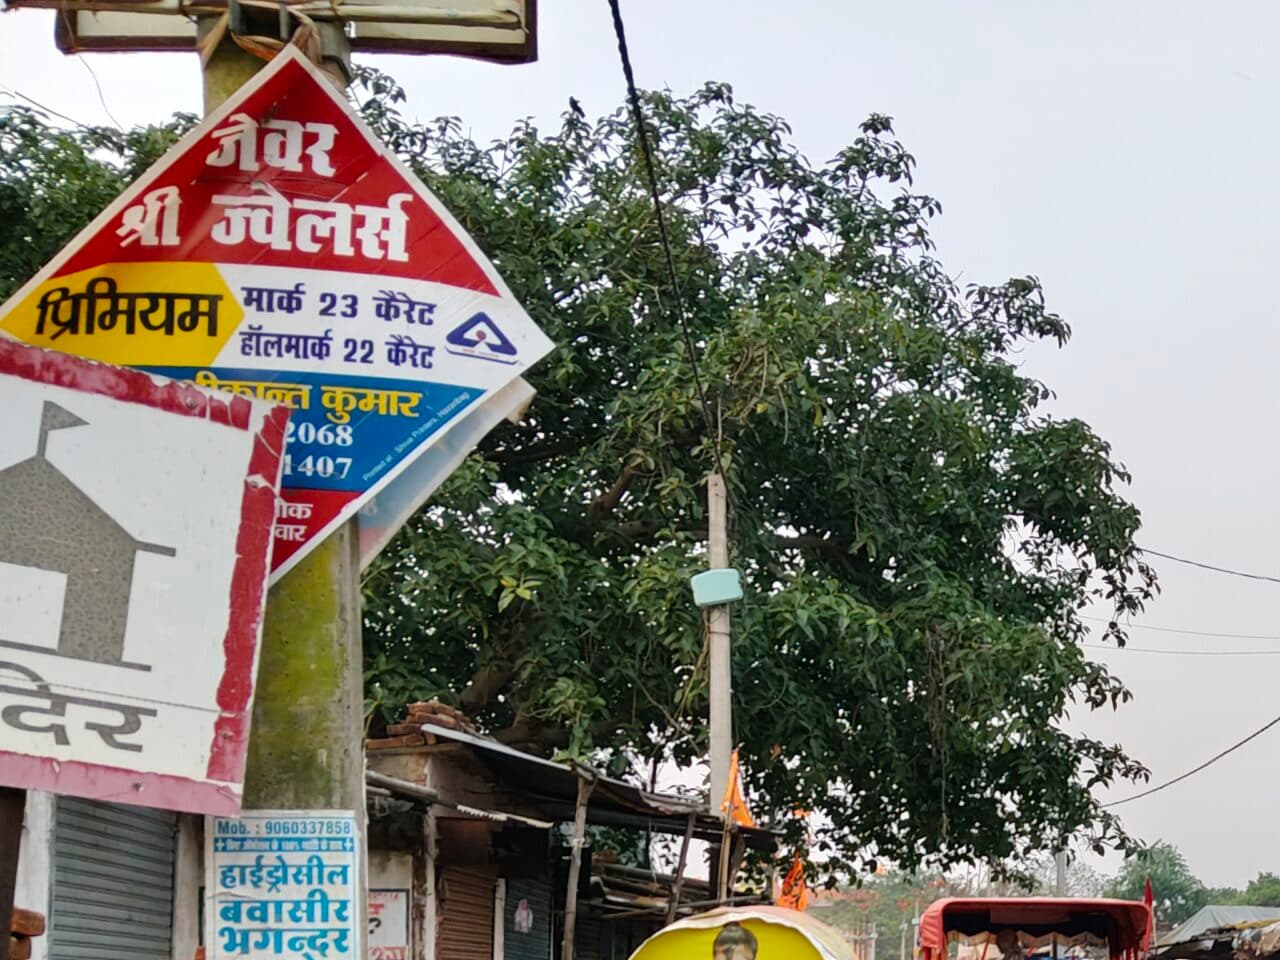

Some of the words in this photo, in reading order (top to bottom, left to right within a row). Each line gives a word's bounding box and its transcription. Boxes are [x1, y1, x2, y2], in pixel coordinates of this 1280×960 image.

[206, 112, 340, 177] जेवर
[116, 185, 181, 247] श्री
[211, 181, 413, 262] ज्वेलर्स
[35, 277, 223, 340] प्रिमियम
[240, 284, 306, 315] मार्क
[319, 293, 358, 319] 23
[373, 290, 437, 327] कैरेट
[240, 326, 332, 362] हॉलमार्क
[343, 339, 374, 365] 22
[386, 341, 434, 370] कैरेट
[321, 385, 422, 424] कुमार
[265, 821, 350, 835] 9060337858
[218, 855, 352, 893] हाईड्रोसील
[218, 888, 351, 924] बवासीर
[218, 927, 352, 958] भगन्दर
